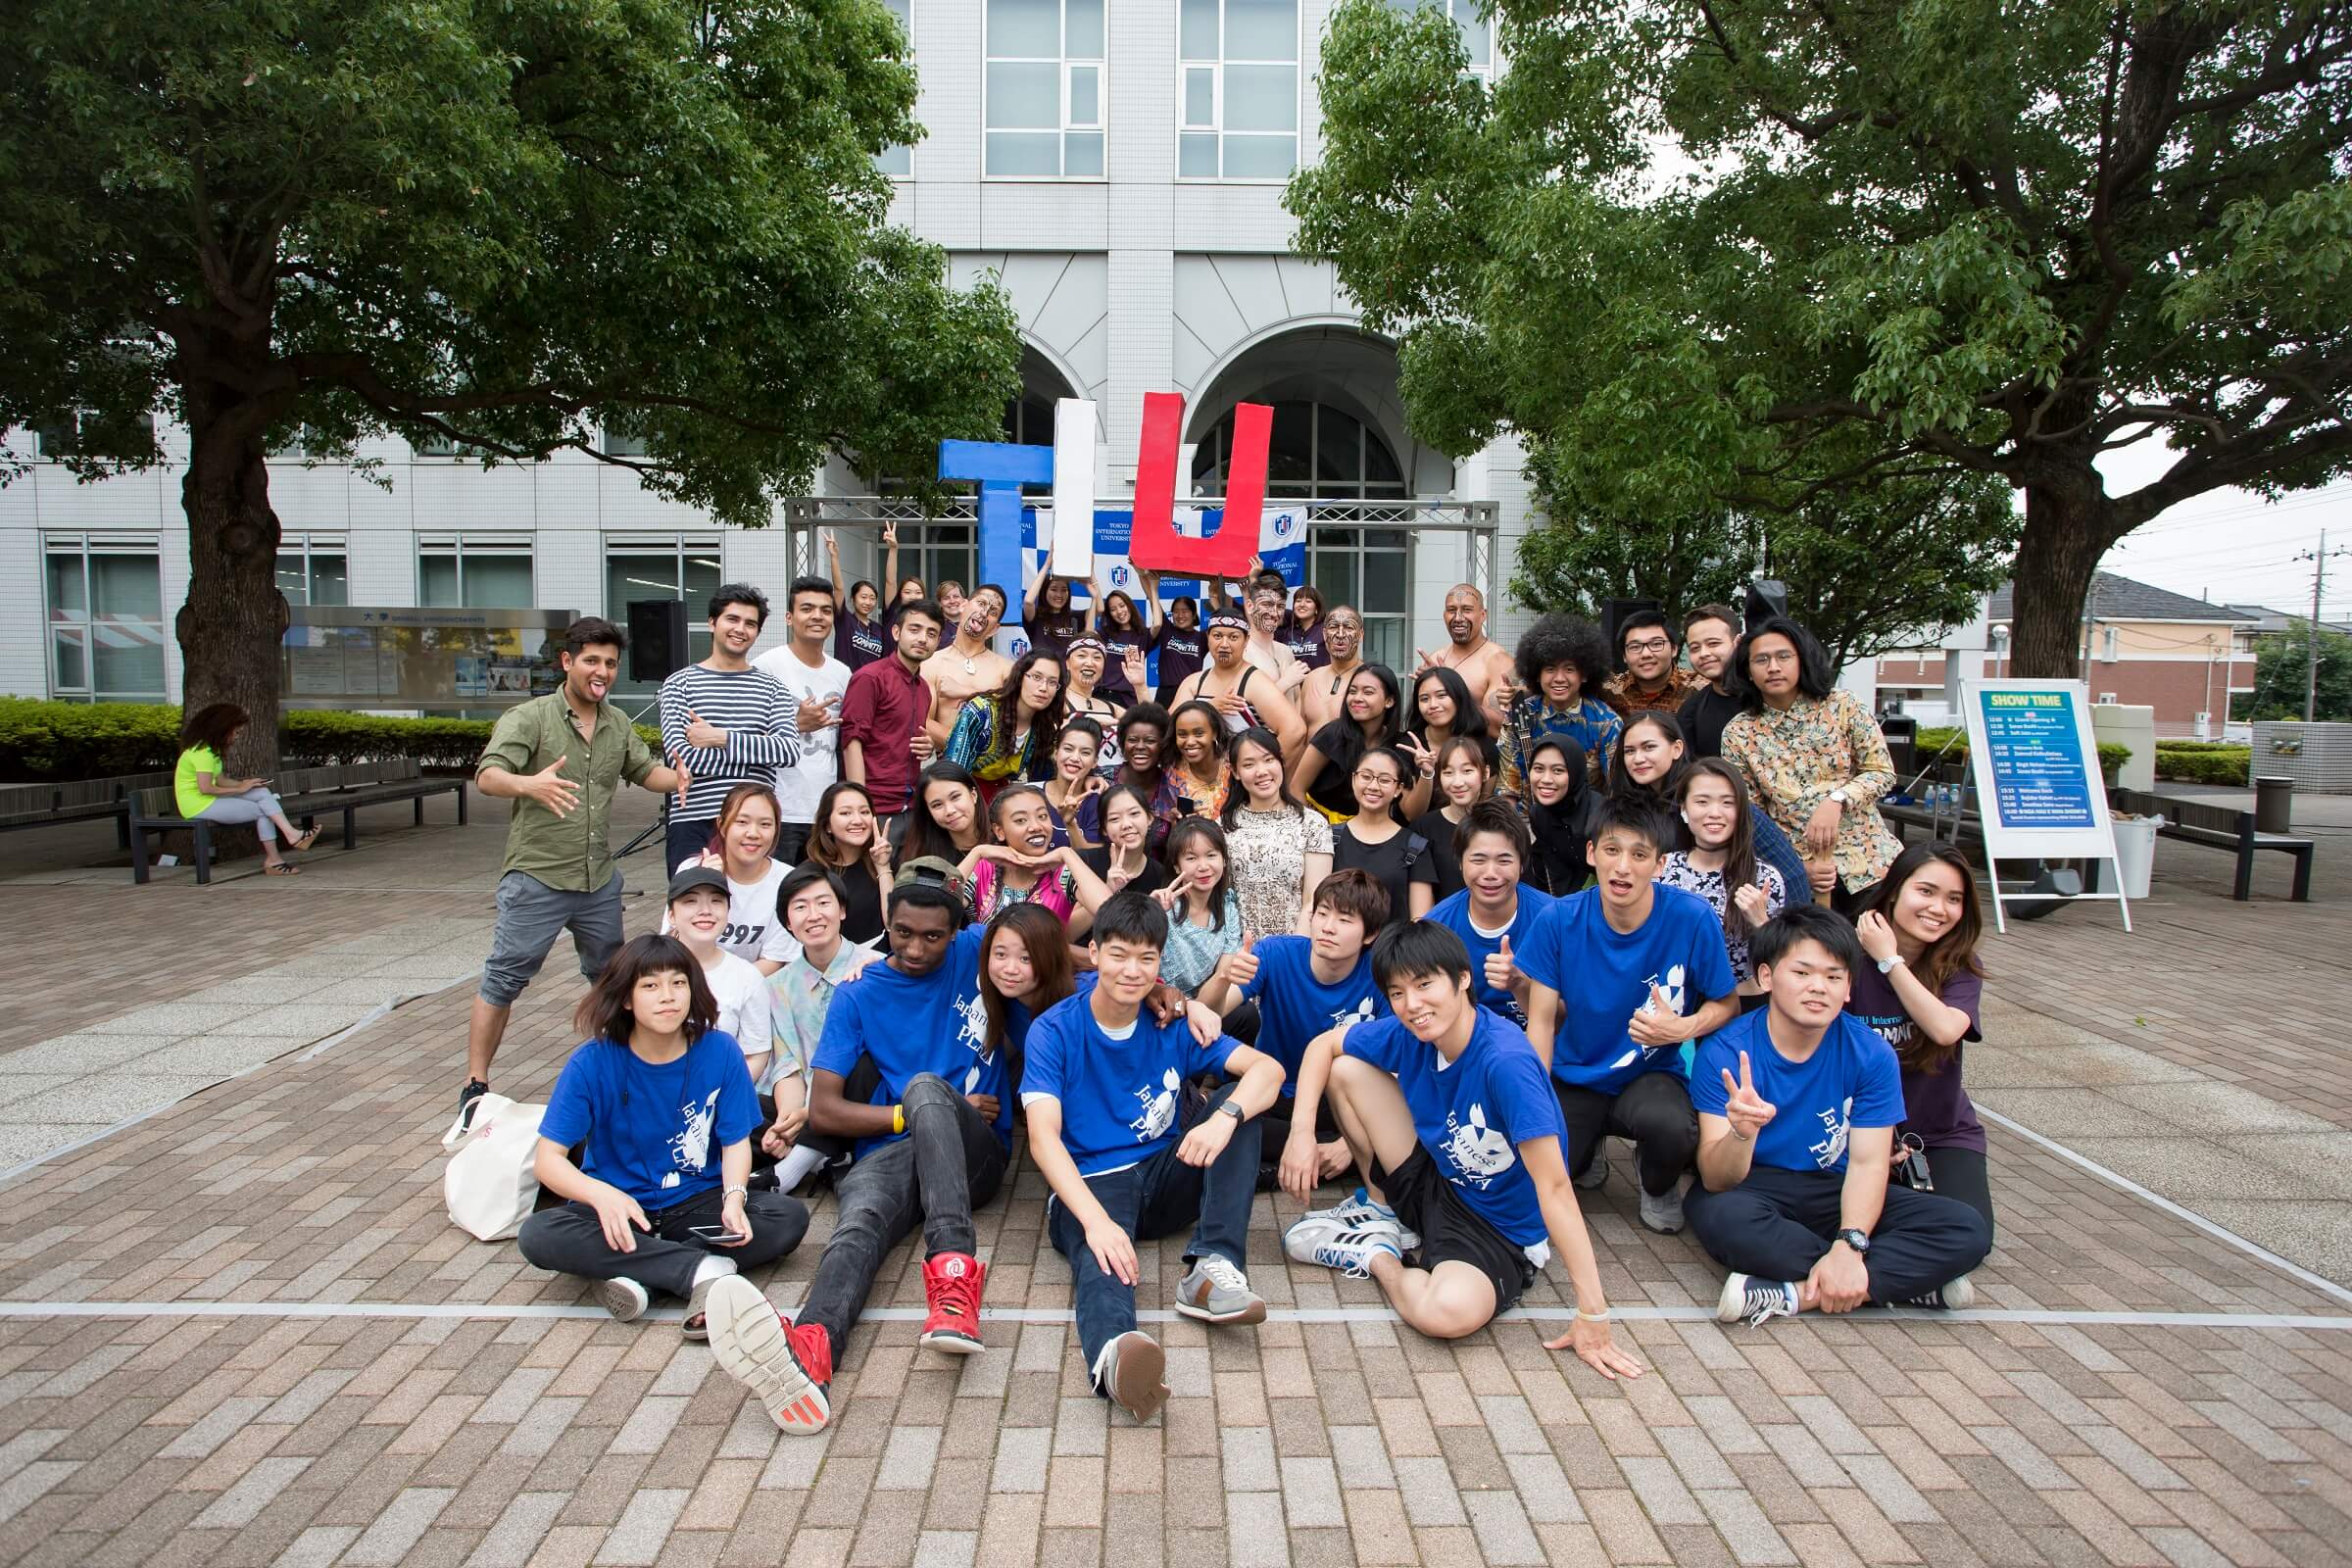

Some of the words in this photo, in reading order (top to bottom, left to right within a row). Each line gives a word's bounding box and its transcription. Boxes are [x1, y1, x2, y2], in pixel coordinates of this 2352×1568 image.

[852, 635, 882, 653] COMMITTE
[1991, 695, 2029, 706] SHOW
[2031, 696, 2062, 706] TIME
[953, 993, 988, 1026] Japan
[1133, 1083, 1168, 1128] Japane
